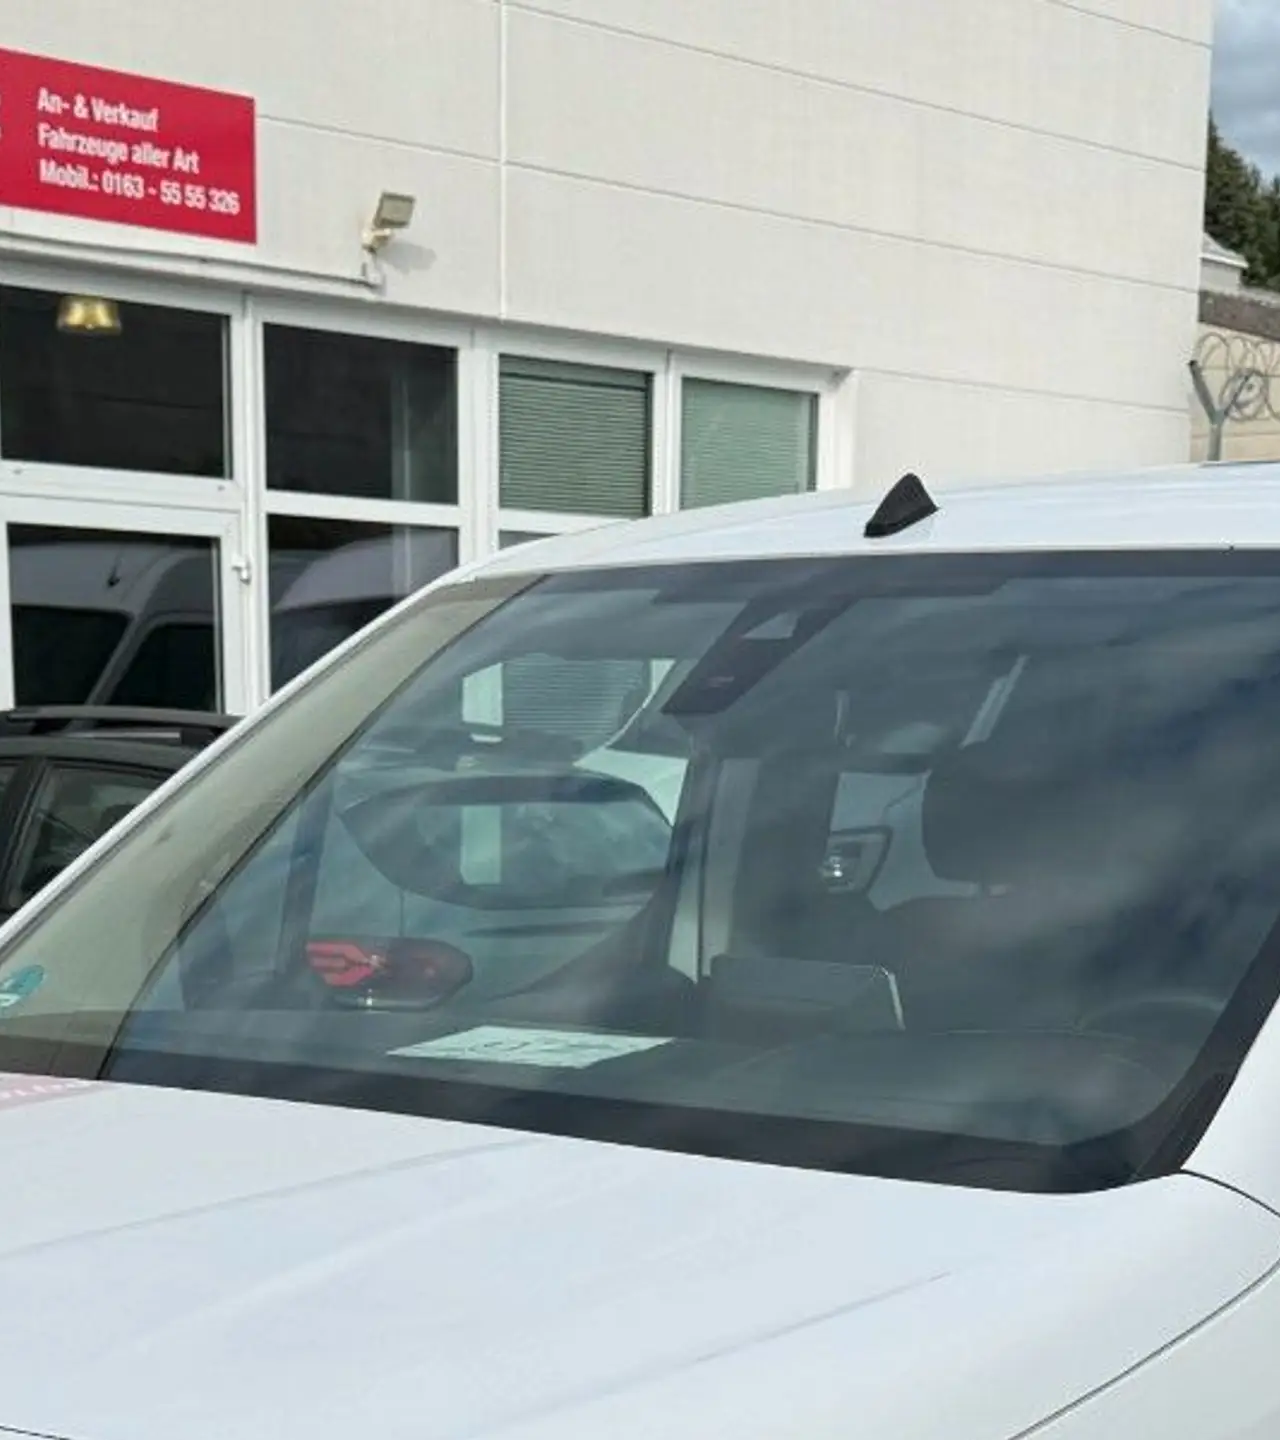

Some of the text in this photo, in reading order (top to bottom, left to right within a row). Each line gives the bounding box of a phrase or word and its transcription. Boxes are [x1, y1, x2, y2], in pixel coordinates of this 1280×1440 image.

[38, 87, 159, 132] An- & Verkauf
[37, 123, 200, 174] Fahrzeuge aller Art
[102, 170, 145, 199] 0163
